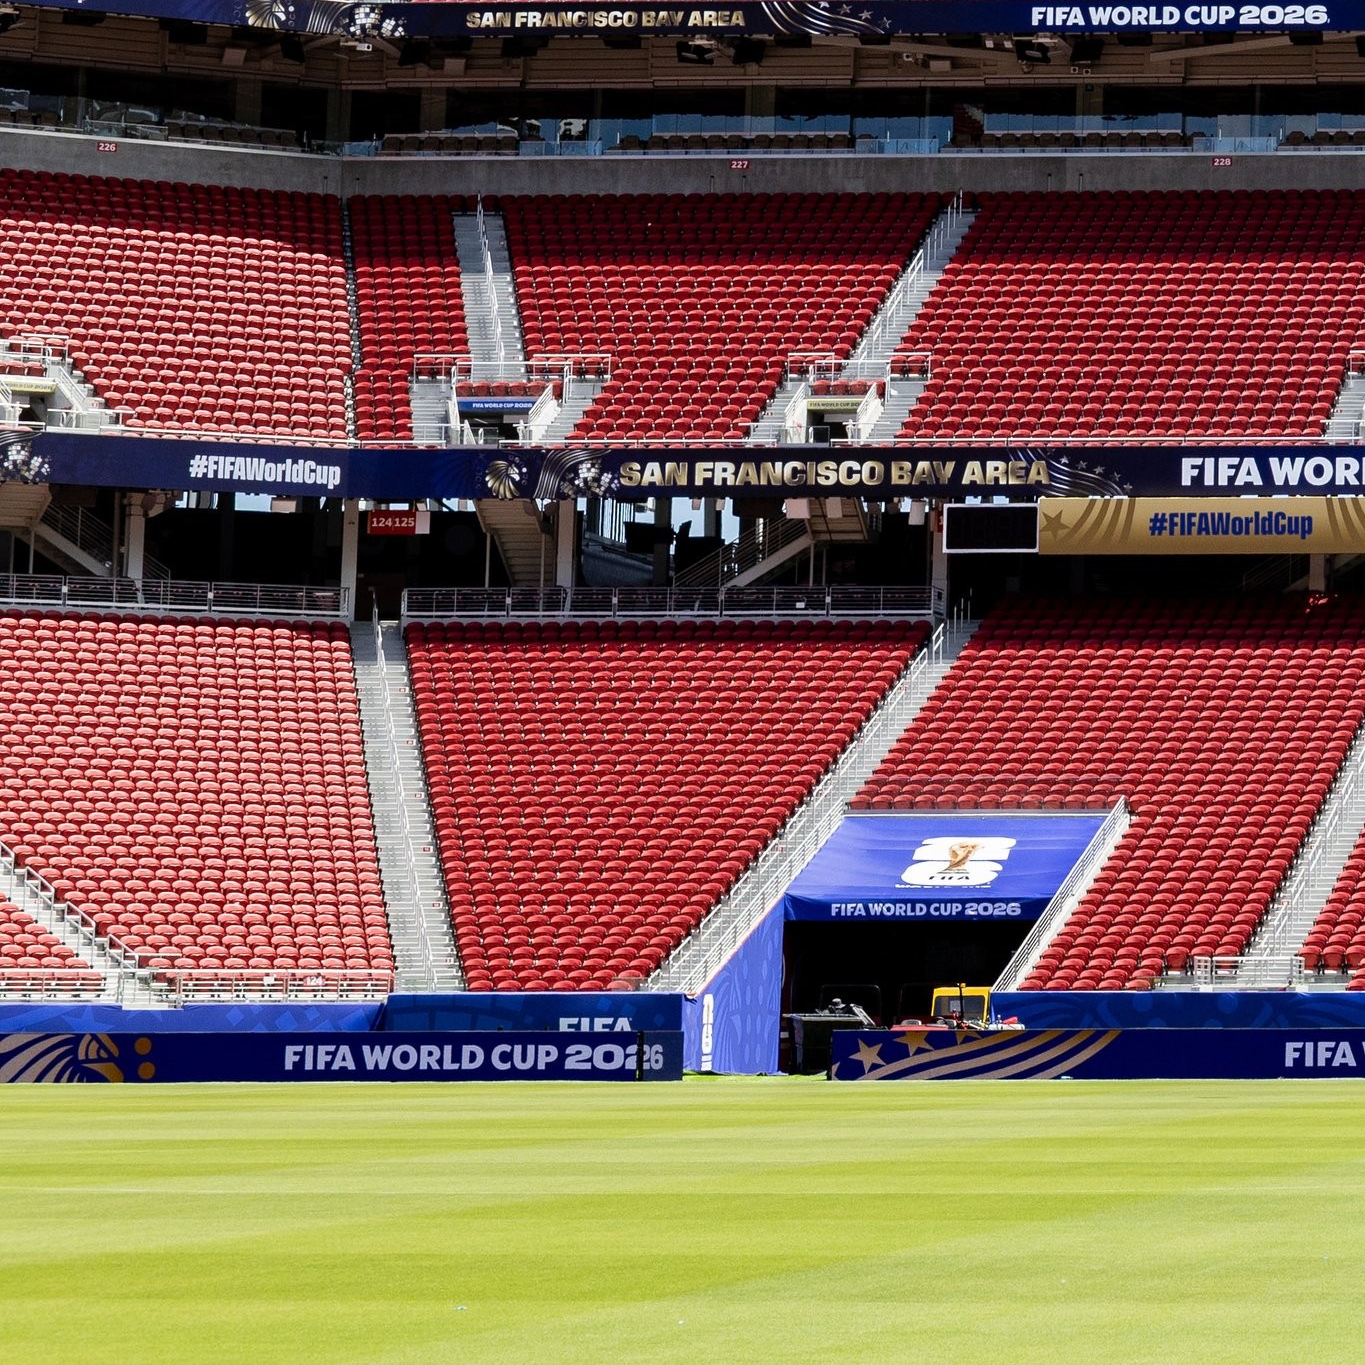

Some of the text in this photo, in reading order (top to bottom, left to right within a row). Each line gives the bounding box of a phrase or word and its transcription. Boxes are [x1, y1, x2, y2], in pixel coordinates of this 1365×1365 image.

[465, 10, 745, 28] SAN FRANCISCO BAY AREA
[1031, 4, 1328, 26] FIFA WORLD CUP 2026
[98, 143, 117, 152] 226
[731, 161, 748, 169] 227
[1214, 158, 1231, 166] 228
[189, 454, 341, 489] #FIFAWorldCup
[619, 459, 1051, 487] SAN FRANCISCO BAY AREA
[1181, 457, 1263, 486] FIFA
[370, 516, 392, 528] 124
[394, 516, 416, 528] 125
[1149, 510, 1313, 540] #FIFAWorldCup
[831, 902, 1022, 917] FIFA WORLD CUP 2026
[306, 975, 323, 985] 124
[284, 1045, 355, 1071] FIFA
[362, 1045, 486, 1071] WORLD
[491, 1044, 559, 1071] CUP
[1285, 1041, 1356, 1068] FIFA
